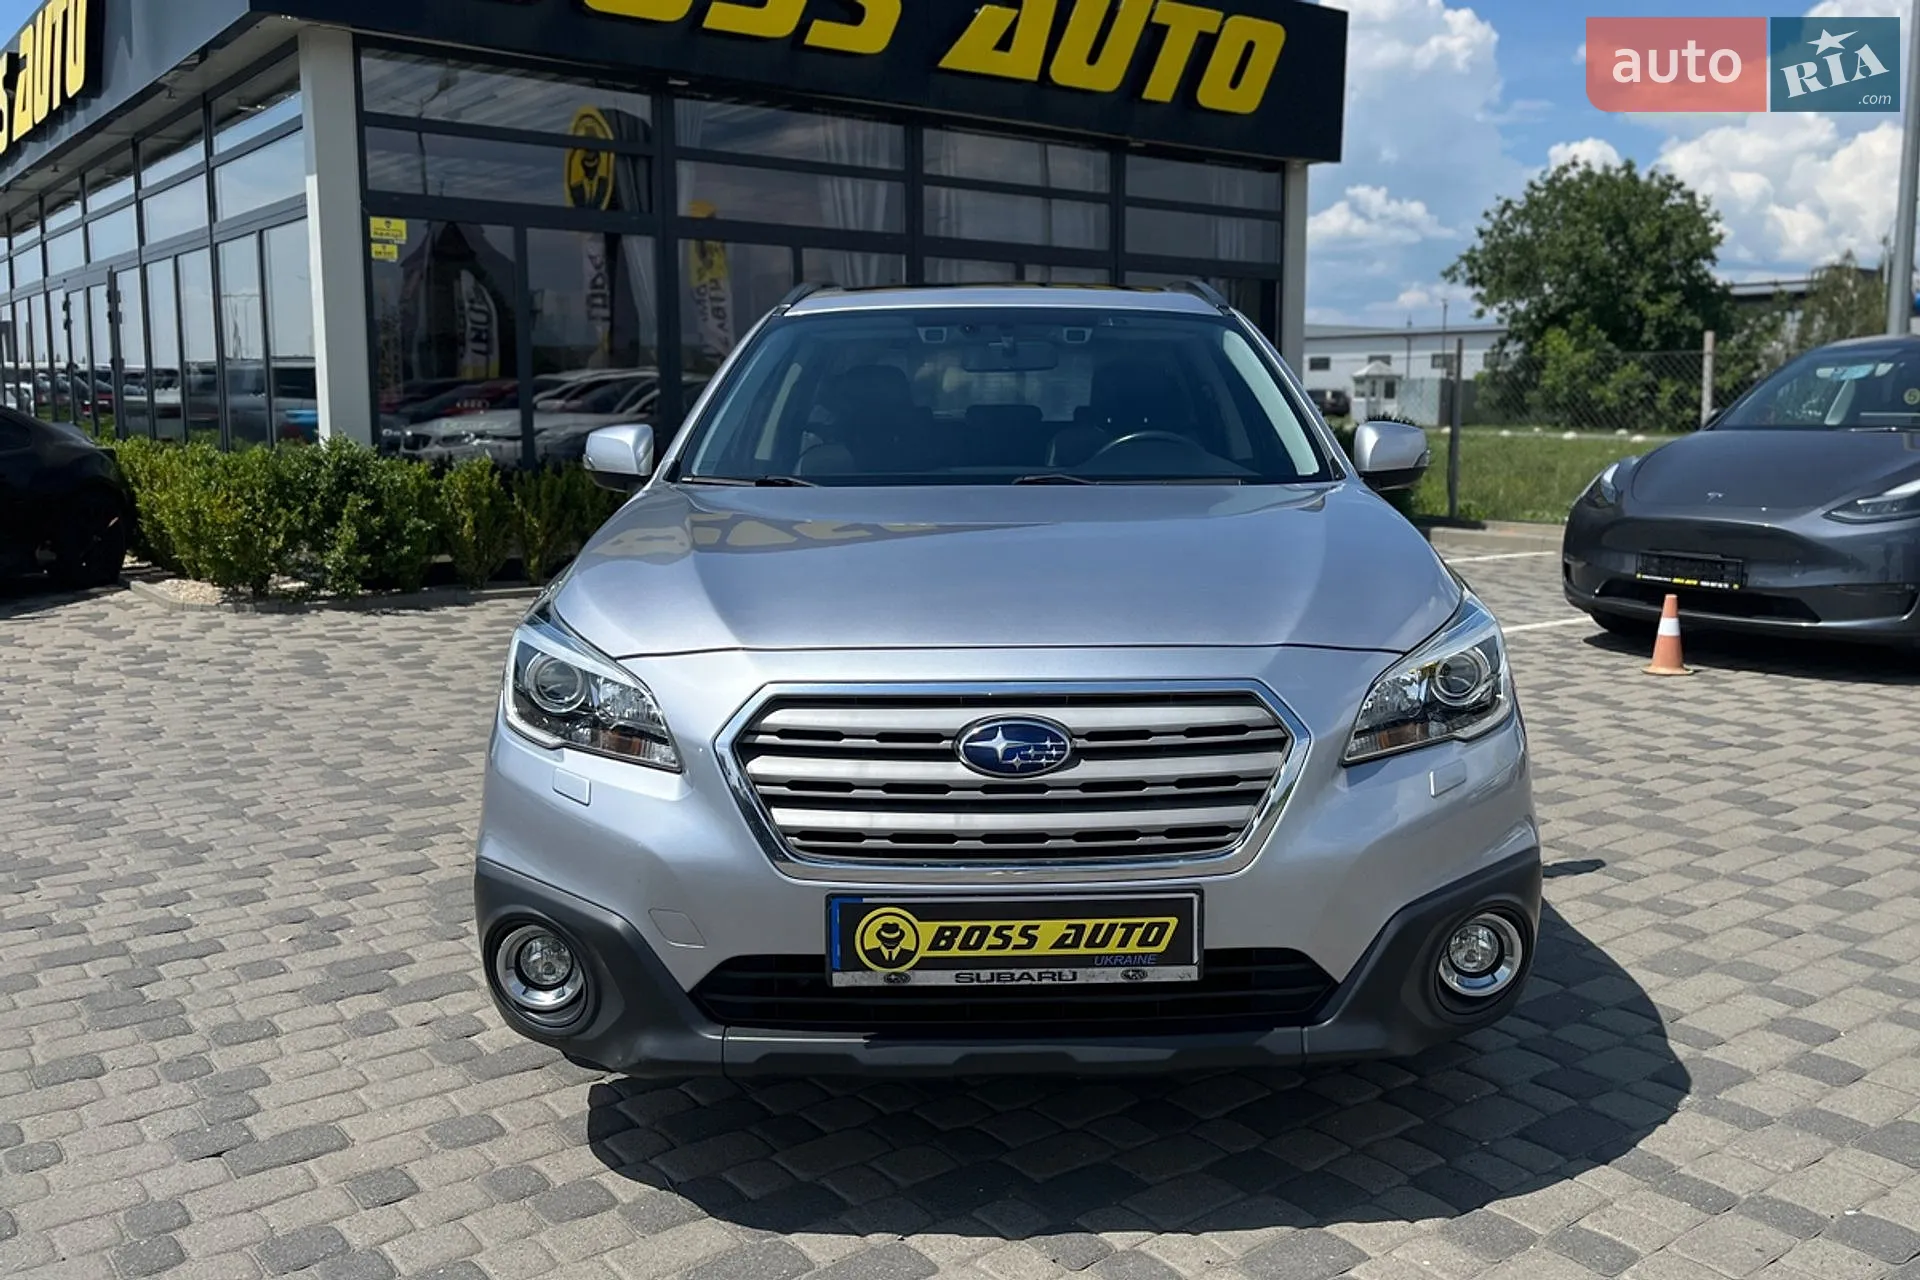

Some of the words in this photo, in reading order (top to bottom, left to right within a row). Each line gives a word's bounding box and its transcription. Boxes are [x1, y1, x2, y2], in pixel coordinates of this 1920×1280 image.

[12, 0, 87, 142] AUTO
[937, 0, 1287, 115] AUTO
[926, 924, 1040, 952] BOSS
[1048, 920, 1177, 951] AUTO
[1094, 954, 1157, 966] UKRAINE
[954, 970, 1078, 984] SUBARU
